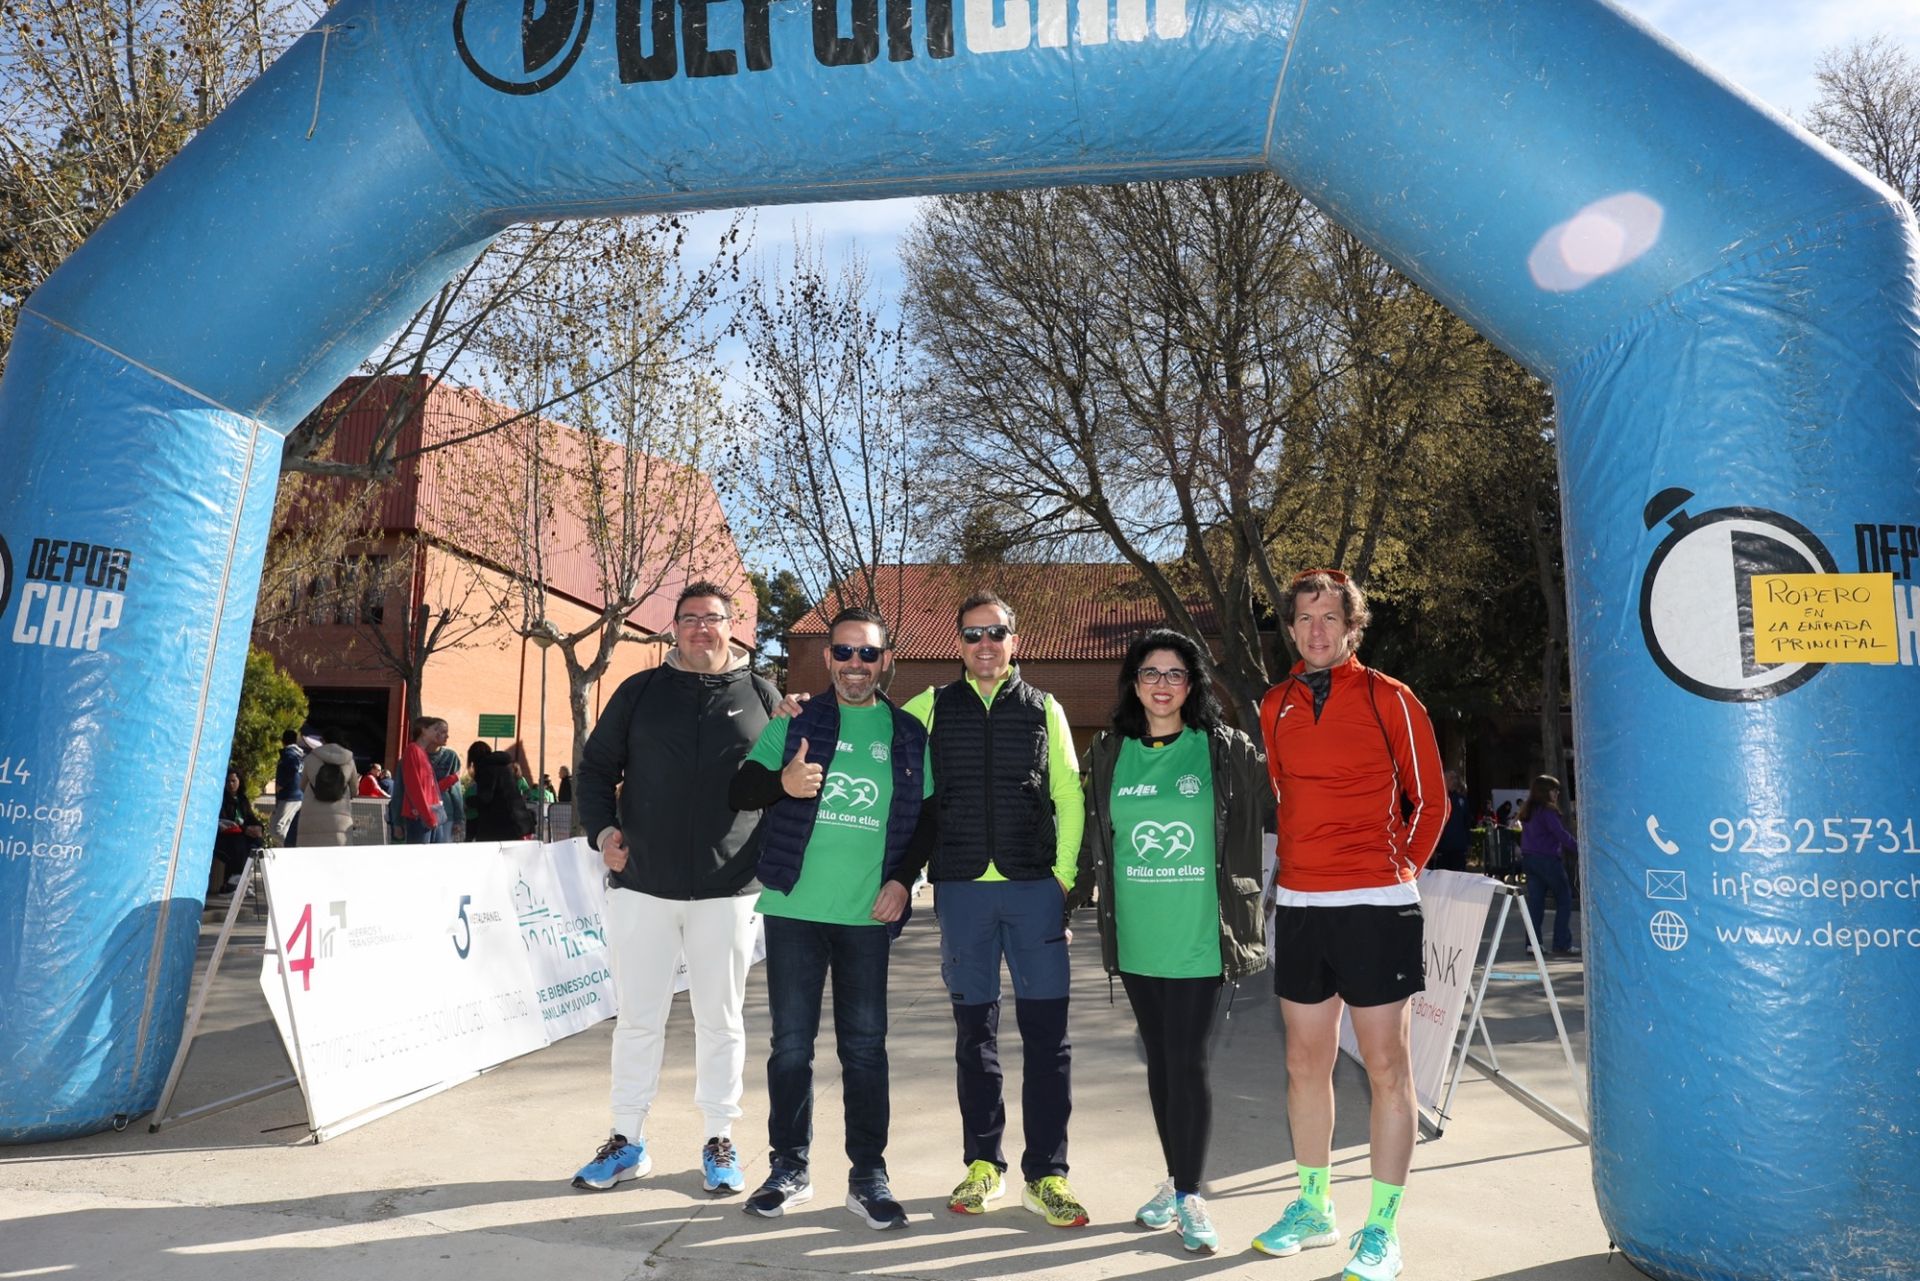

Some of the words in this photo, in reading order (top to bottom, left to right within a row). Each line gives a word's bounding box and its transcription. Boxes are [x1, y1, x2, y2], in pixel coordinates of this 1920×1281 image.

[1854, 523, 1920, 580] DEP
[26, 538, 131, 592] DEPOR
[1765, 578, 1871, 606] ROPERO
[12, 582, 126, 651] CHIP
[1804, 608, 1824, 618] EN
[1768, 621, 1789, 633] LA
[1771, 636, 1888, 652] PRINCIPAL
[839, 813, 857, 824] con
[859, 816, 880, 828] ellos
[1126, 865, 1154, 877] Brilla
[1156, 867, 1176, 877] con
[1178, 865, 1206, 876] ellos
